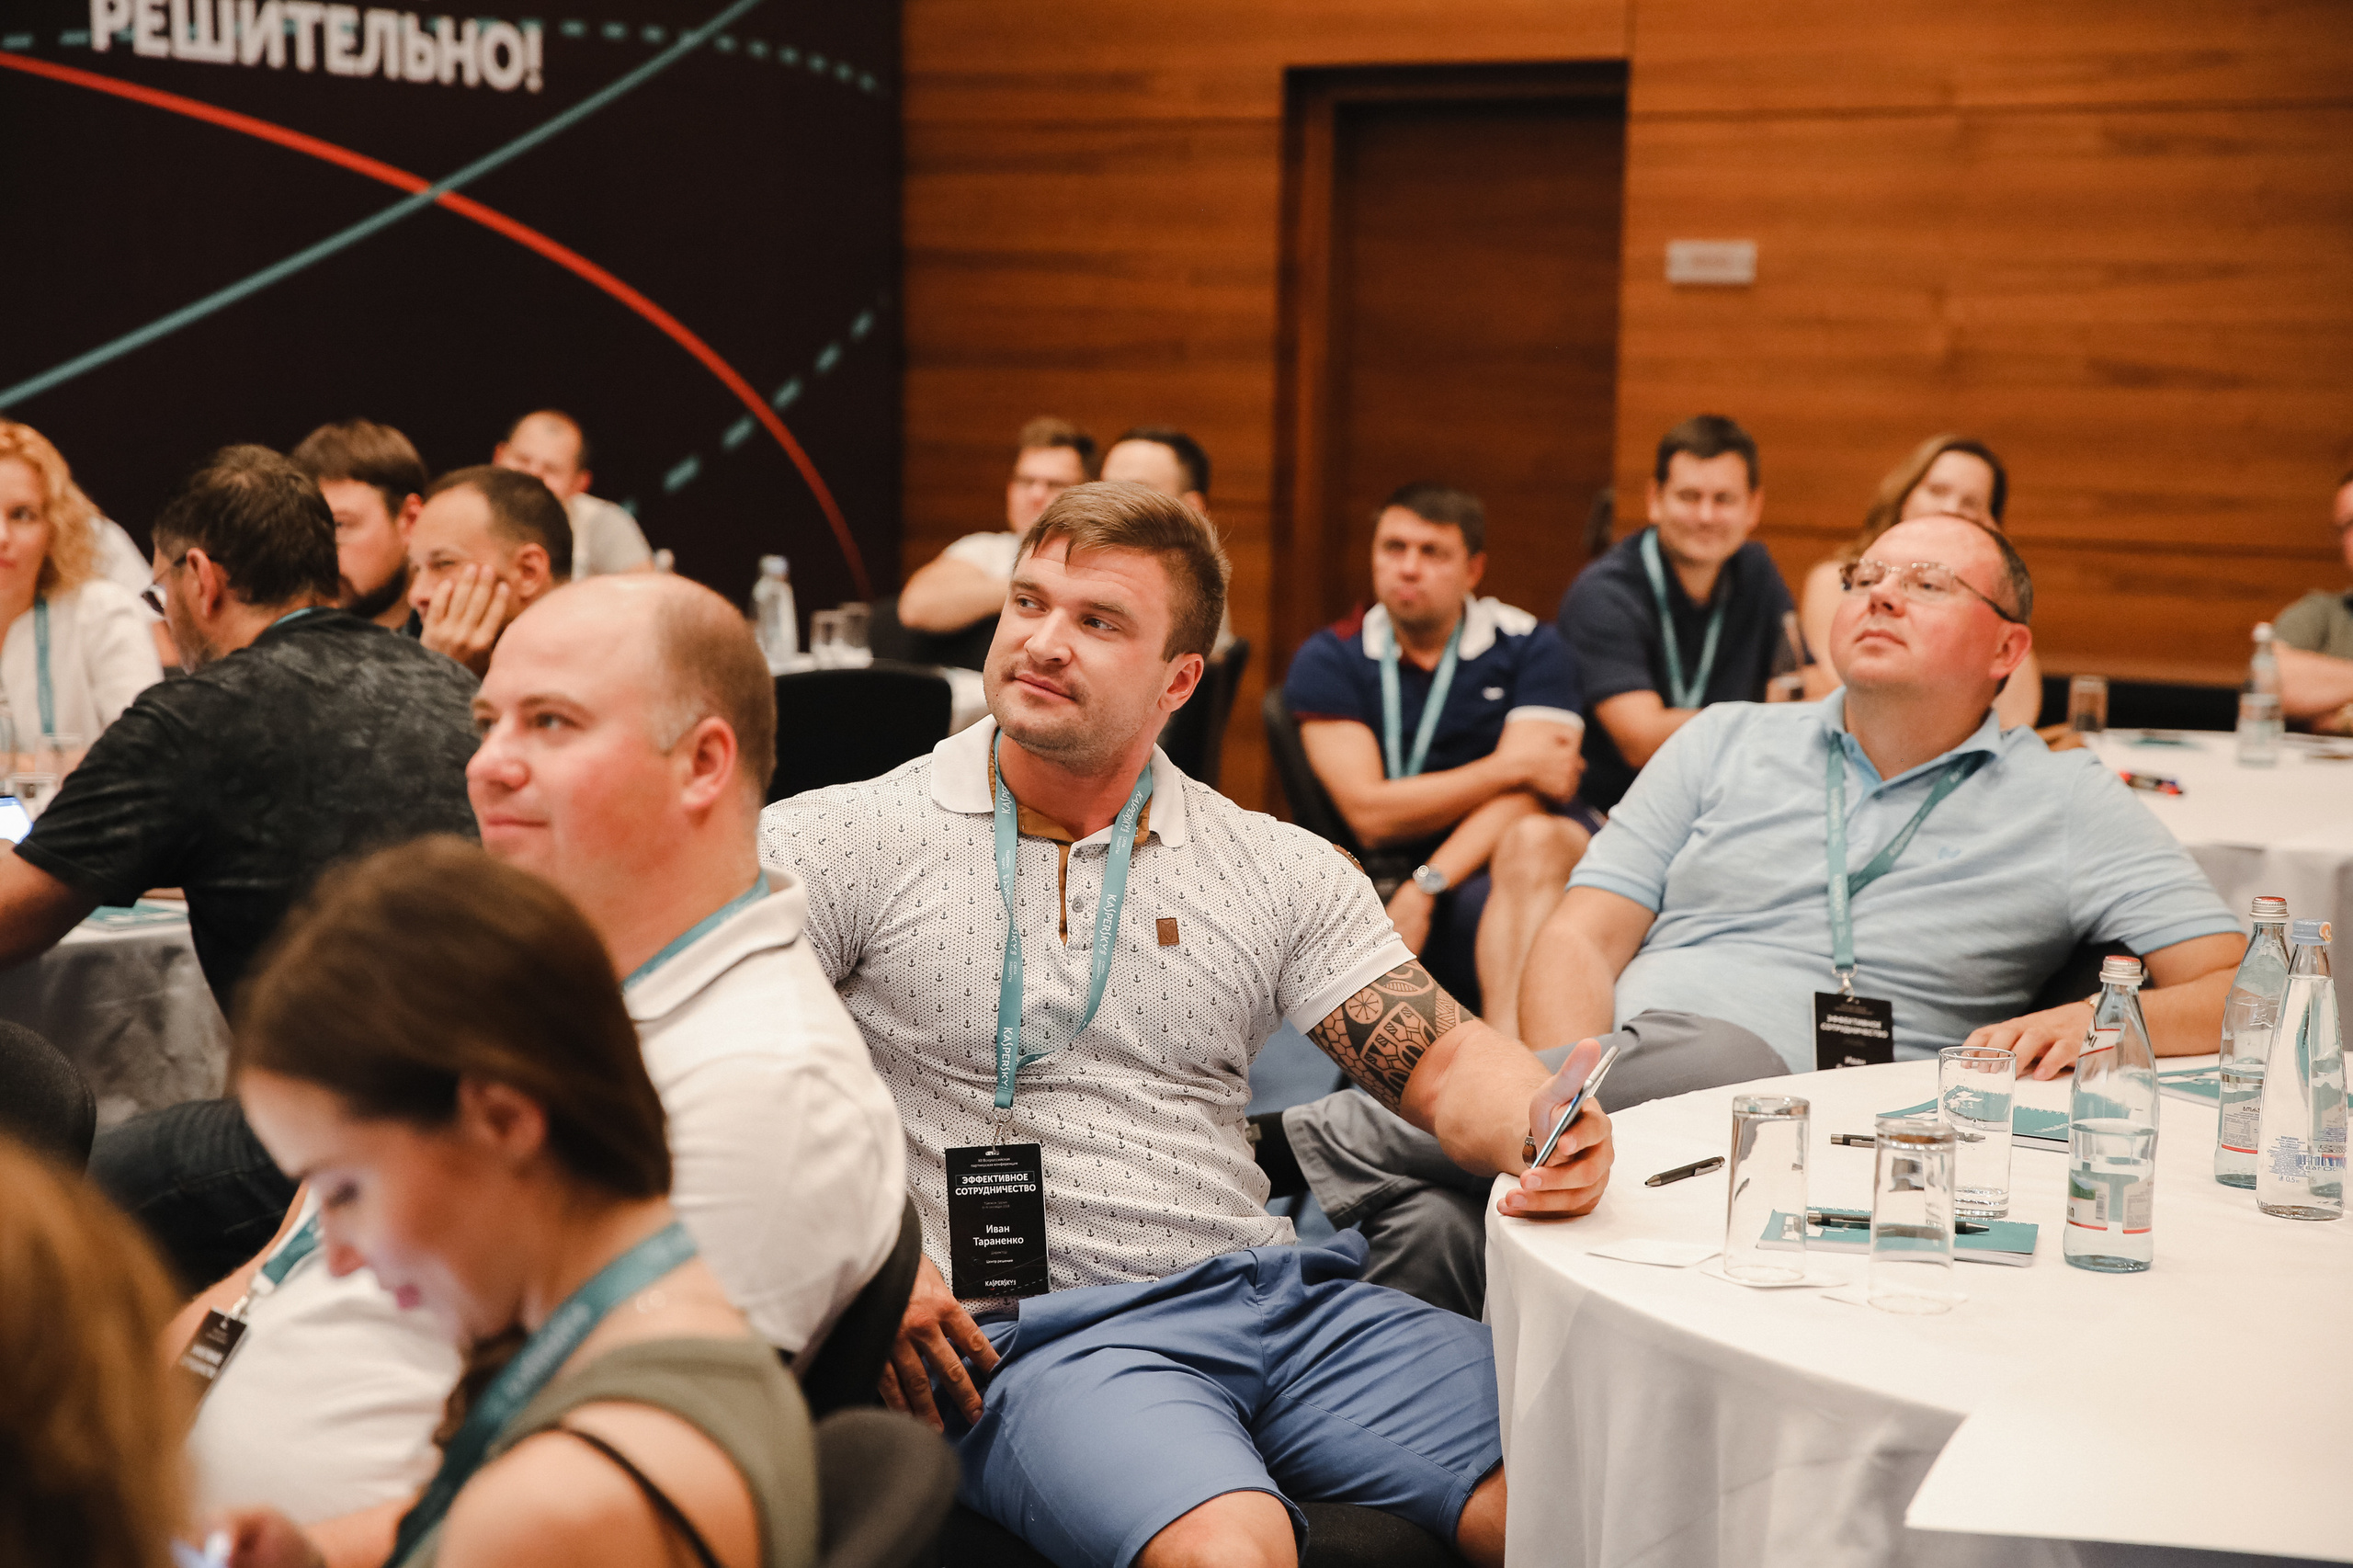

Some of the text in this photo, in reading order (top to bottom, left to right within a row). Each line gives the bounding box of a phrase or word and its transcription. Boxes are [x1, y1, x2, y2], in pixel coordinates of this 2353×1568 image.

[91, 0, 544, 92] РЕШИТЕЛЬНО!
[1121, 790, 1143, 830] KASPERSKY
[1099, 893, 1117, 951] KASPERSKY
[1000, 1027, 1013, 1086] KASPERSKY
[955, 1184, 1037, 1196] СОТРУДНИЧЕСТВО
[961, 1173, 1029, 1184] ЭФФЕКТИВНОЕ
[972, 1236, 1024, 1247] Тараненко
[985, 1224, 1010, 1233] Иван
